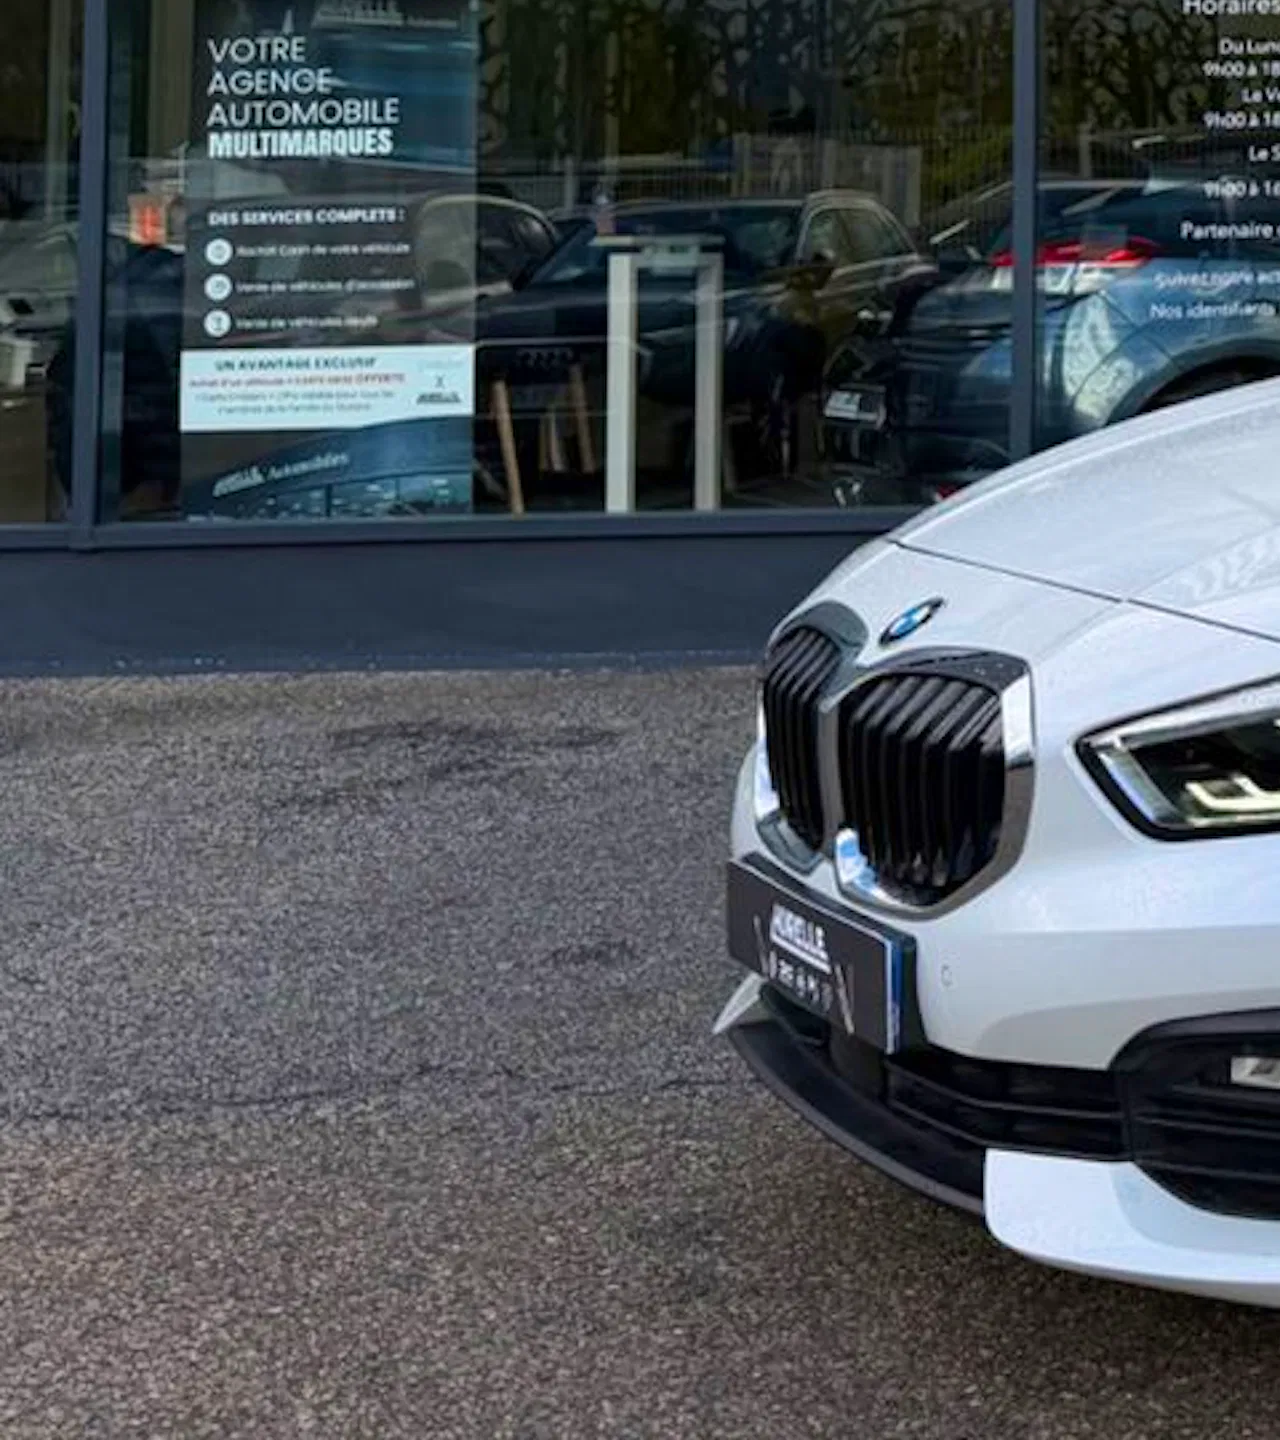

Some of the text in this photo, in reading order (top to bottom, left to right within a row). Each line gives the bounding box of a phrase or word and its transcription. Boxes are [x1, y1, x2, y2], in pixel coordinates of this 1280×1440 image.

[207, 36, 307, 63] VOTRE
[1219, 38, 1244, 55] Du
[207, 67, 333, 97] AGENCE
[1241, 88, 1263, 103] Le
[207, 97, 400, 127] AUTOMOBILE
[208, 127, 394, 158] MULTIMARQUES
[1249, 145, 1269, 162] Le
[208, 211, 239, 226] DES
[241, 209, 313, 225] SERVICES
[316, 207, 396, 224] COMPLETS
[1180, 220, 1274, 241] Partenaire
